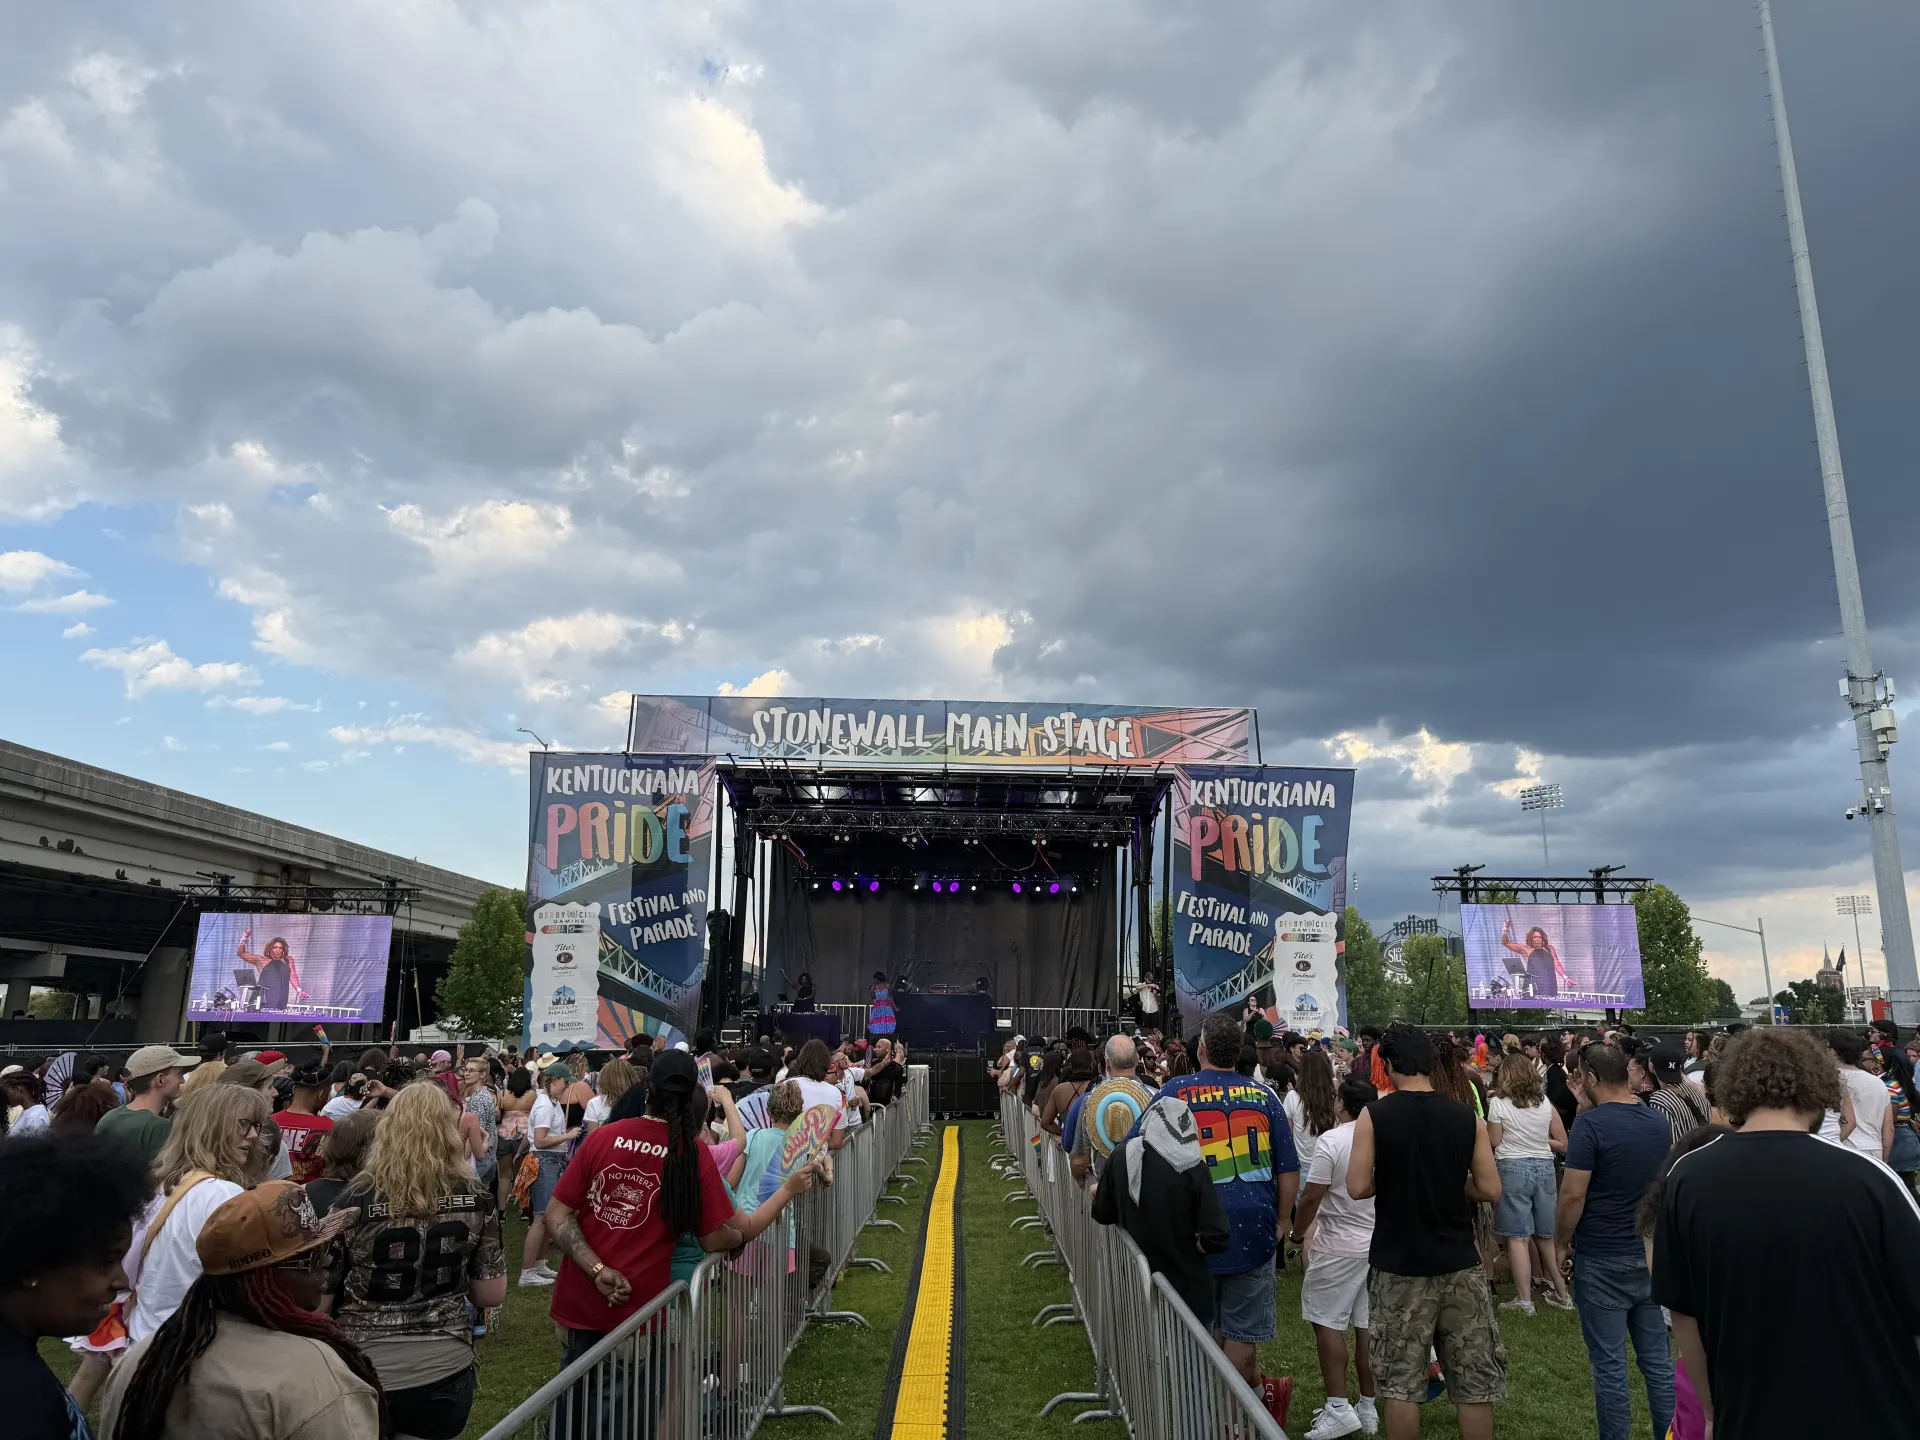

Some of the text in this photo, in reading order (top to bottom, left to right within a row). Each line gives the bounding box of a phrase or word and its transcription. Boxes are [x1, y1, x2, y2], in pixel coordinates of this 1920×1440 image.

[750, 706, 933, 750] STONEWALL
[1042, 711, 1135, 761] STAGE
[682, 887, 706, 906] AND
[1249, 910, 1269, 927] AND
[630, 913, 698, 951] PARADE
[1188, 922, 1253, 957] PARADE
[554, 943, 576, 952] Tito's
[1293, 951, 1315, 960] Tito's
[1176, 1085, 1225, 1104] STAY
[608, 1172, 654, 1190] NO HATERZ
[601, 1211, 630, 1226] RIDERS
[228, 1249, 272, 1269] RODEO
